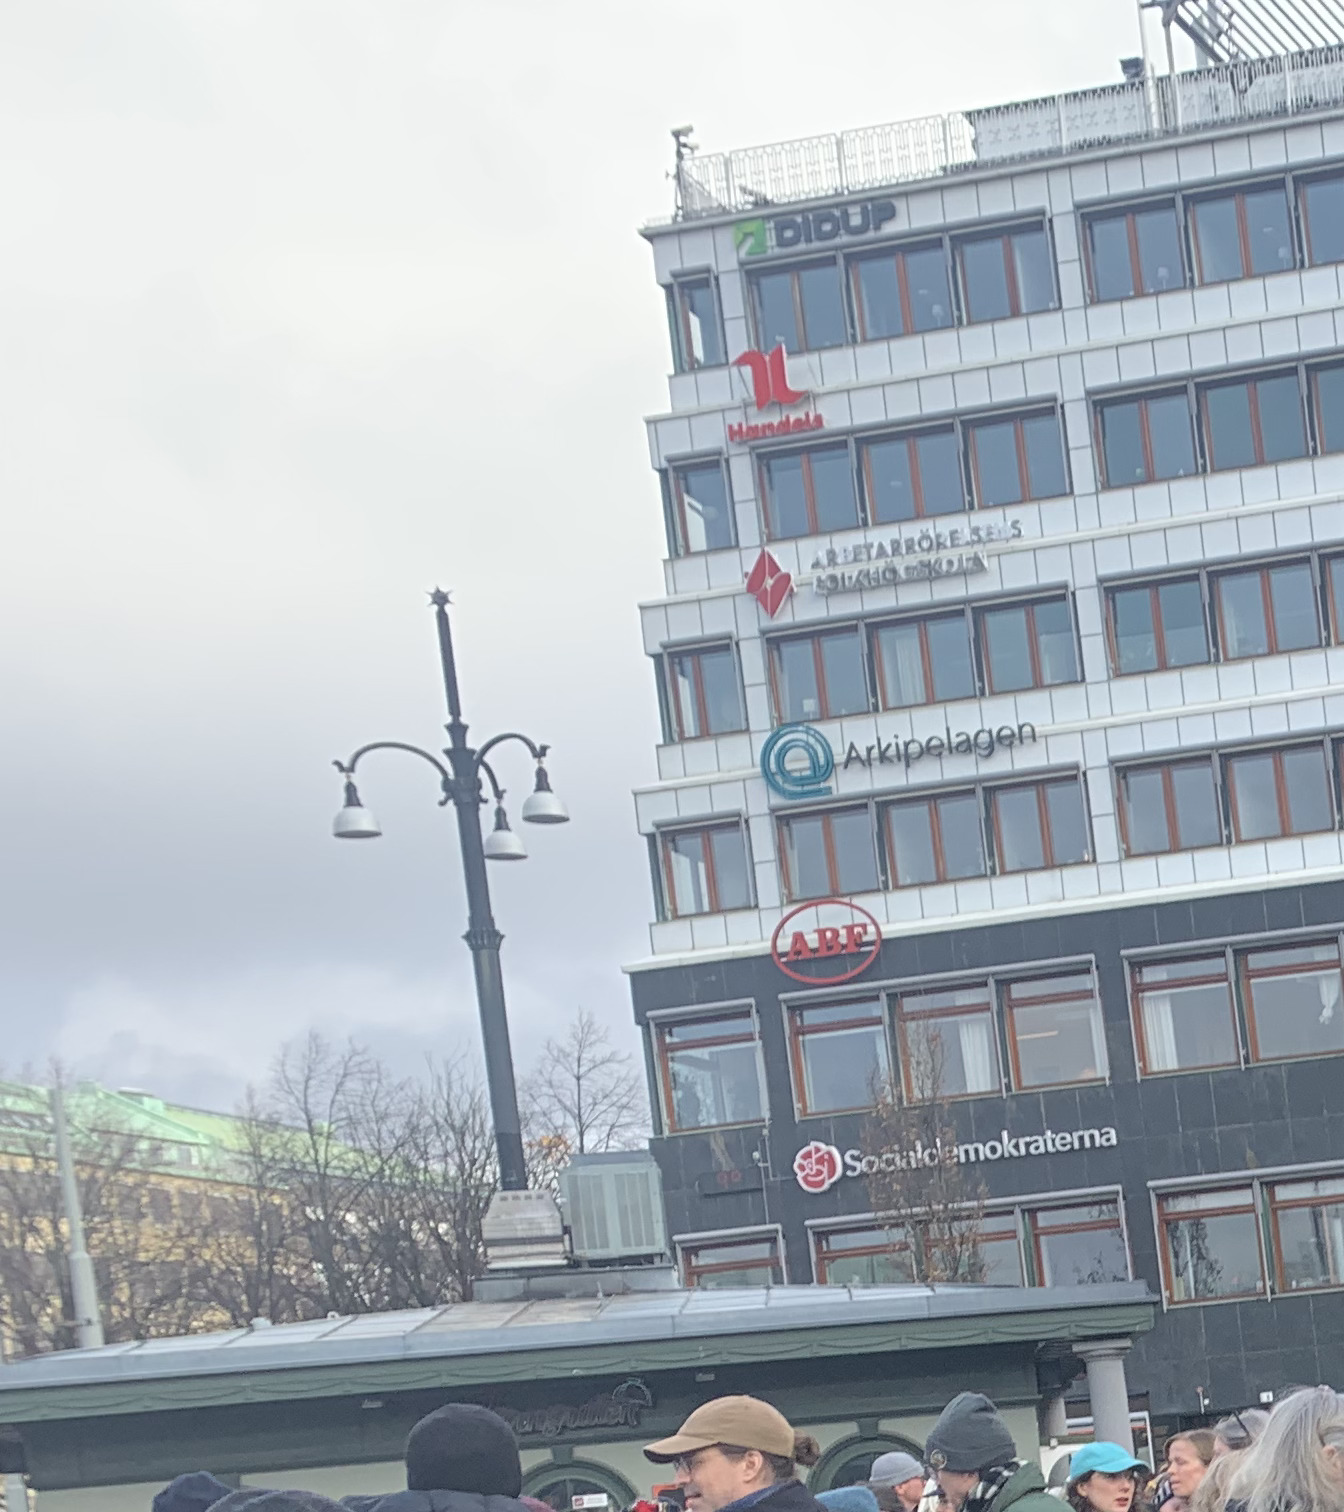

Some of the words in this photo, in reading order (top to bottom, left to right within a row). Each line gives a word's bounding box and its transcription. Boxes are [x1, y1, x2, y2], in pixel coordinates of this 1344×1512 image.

[773, 201, 897, 248] DIDUP
[727, 411, 825, 443] Handels
[843, 721, 1038, 770] Arkipelagen
[786, 922, 868, 962] ABF
[843, 1126, 1118, 1178] Socialdemokraterna
